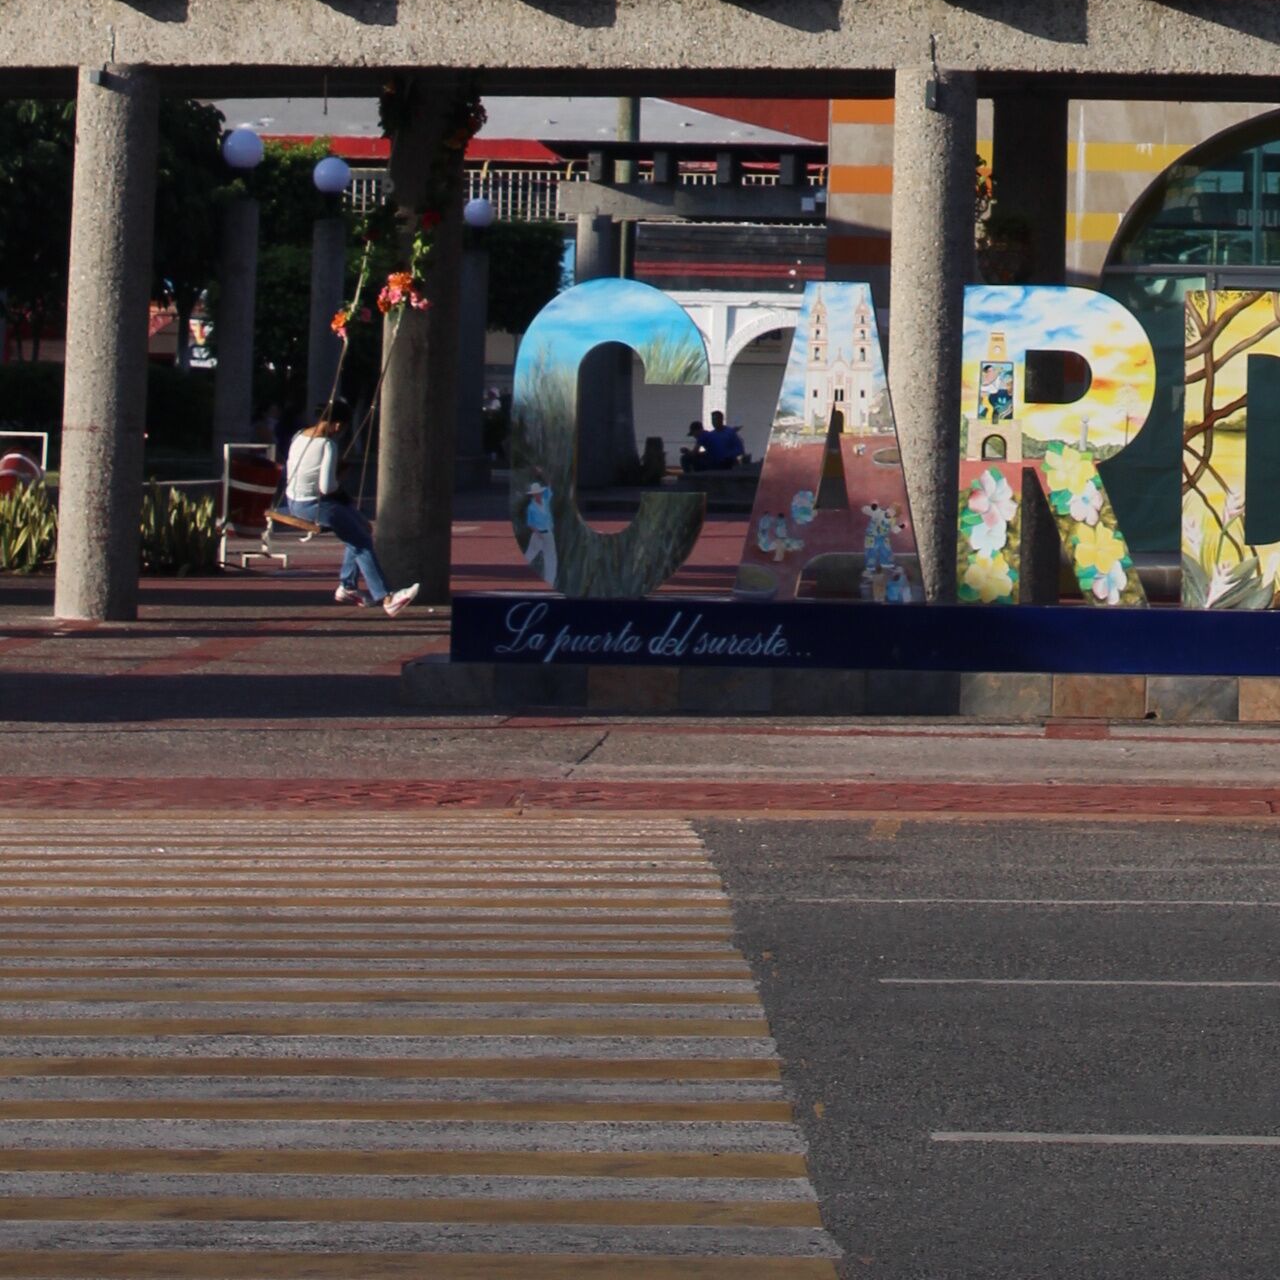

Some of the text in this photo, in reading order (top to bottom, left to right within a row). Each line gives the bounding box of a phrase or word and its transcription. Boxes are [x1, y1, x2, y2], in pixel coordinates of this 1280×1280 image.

[495, 601, 548, 654] La
[544, 620, 642, 663] puerta
[648, 611, 702, 657] del
